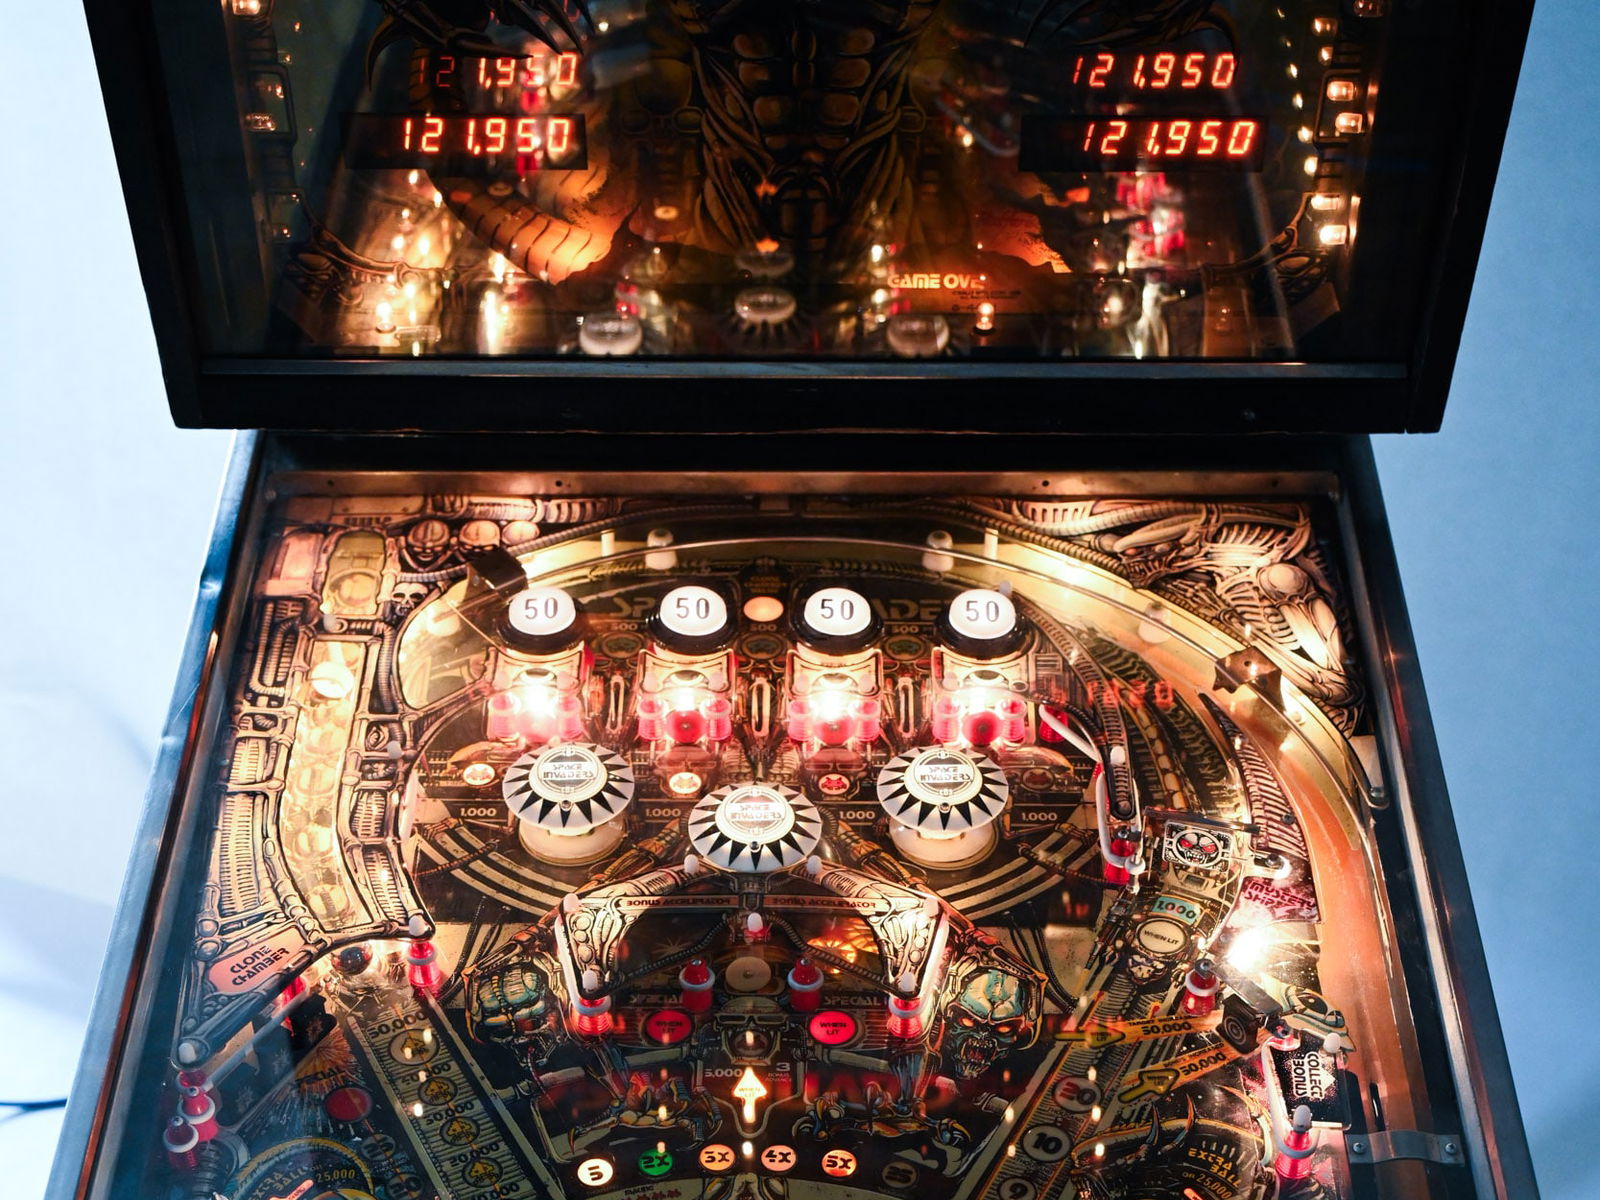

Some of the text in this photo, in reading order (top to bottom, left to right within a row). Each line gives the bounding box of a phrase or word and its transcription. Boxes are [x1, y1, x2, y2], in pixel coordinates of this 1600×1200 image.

[1072, 53, 1237, 90] 121,950
[404, 117, 570, 155] 121,950
[1083, 119, 1257, 156] 121,950
[887, 273, 987, 289] GAME OVE
[524, 597, 559, 620] 50
[676, 597, 710, 620] 50
[820, 598, 855, 621] 50
[965, 599, 1001, 623] 50
[543, 771, 594, 780] INVADERS
[553, 763, 583, 771] SPACE
[920, 773, 971, 783] INVADERS
[928, 765, 958, 774] SPACE
[230, 945, 272, 974] CLONE
[231, 947, 290, 986] CHAMBER
[820, 1021, 847, 1029] WHEN
[775, 1062, 791, 1072] 3
[1293, 1060, 1308, 1096] BONUS
[1307, 1053, 1323, 1098] COLLECT
[1033, 1132, 1062, 1154] 10
[641, 1154, 671, 1168] 2X
[764, 1150, 792, 1164] 4X
[825, 1152, 853, 1171] 5X
[1188, 1147, 1233, 1171] EXTRA
[272, 1167, 307, 1191] BALL
[316, 1169, 356, 1183] 25,000
[588, 1165, 604, 1182] 5
[1209, 1163, 1242, 1188] BALL
[1009, 1183, 1028, 1199] 9
[1195, 1171, 1233, 1200] 25,000
